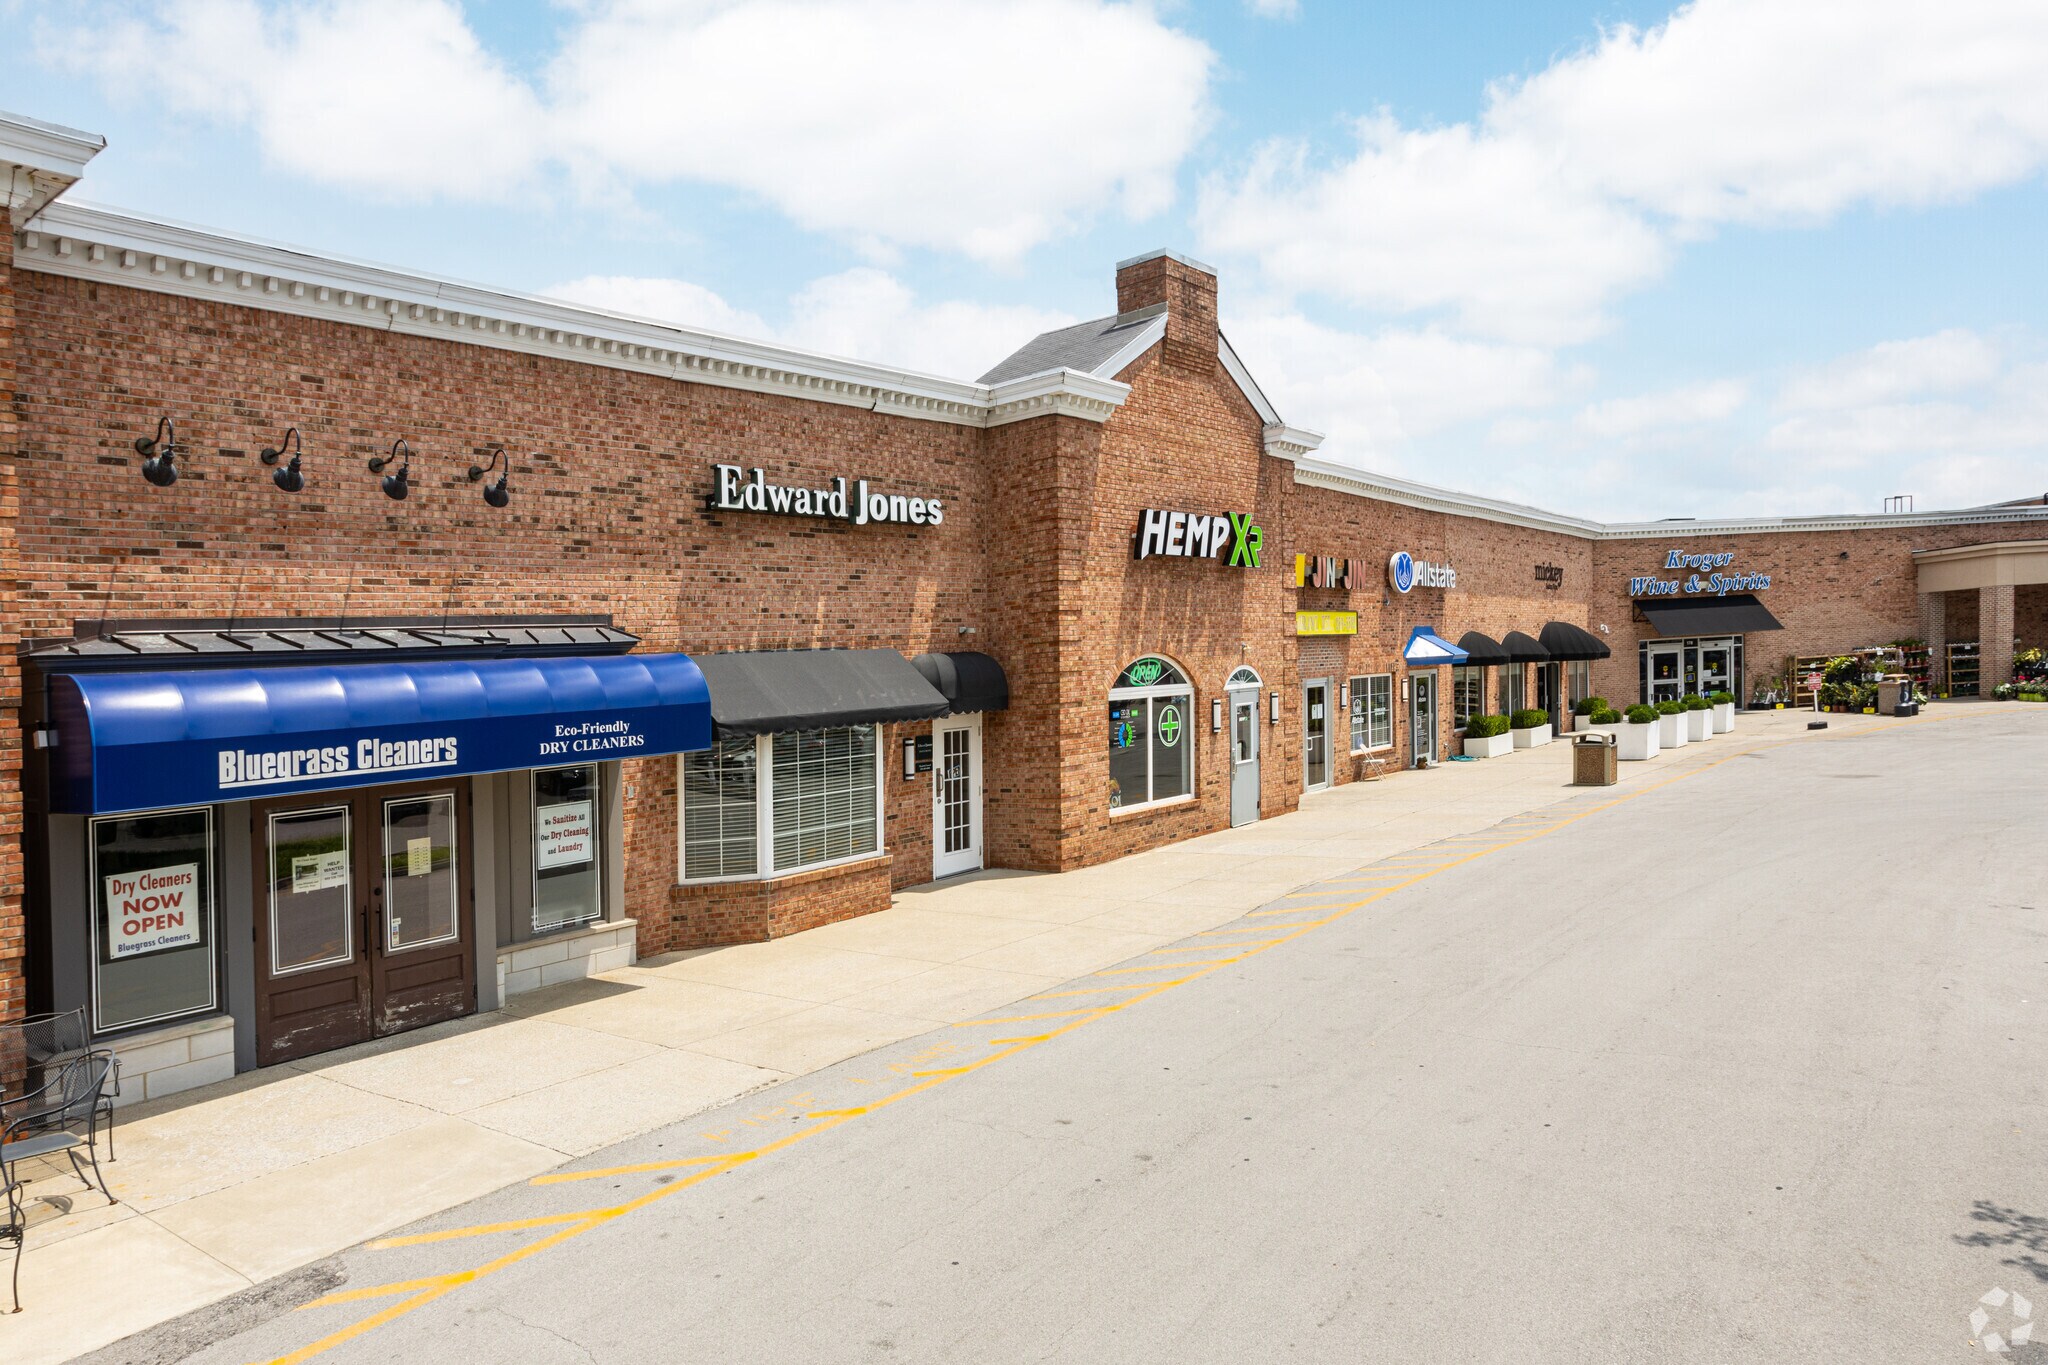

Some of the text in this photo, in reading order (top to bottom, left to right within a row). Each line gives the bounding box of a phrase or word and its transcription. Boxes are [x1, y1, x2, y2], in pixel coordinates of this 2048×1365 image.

[711, 464, 944, 525] Edward Jones
[1665, 549, 1734, 572] Kroger
[1414, 561, 1456, 588] Allstate
[1535, 562, 1563, 588] mickey
[1630, 572, 1771, 596] Wine & Spirits
[1131, 664, 1160, 682] OPEN
[555, 720, 630, 737] Eco-Friendly
[540, 735, 645, 755] DRY CLEANERS
[218, 737, 457, 783] Bluegrass Cleaners
[552, 813, 577, 825] Sanitize
[551, 831, 562, 841] Dry
[563, 827, 589, 838] Cleaning
[558, 842, 583, 853] Laundry
[113, 873, 192, 898] Dry Cleaners
[123, 891, 183, 915] NOW
[122, 911, 184, 936] OPEN
[118, 933, 191, 952] Bluegrass Cleaners
